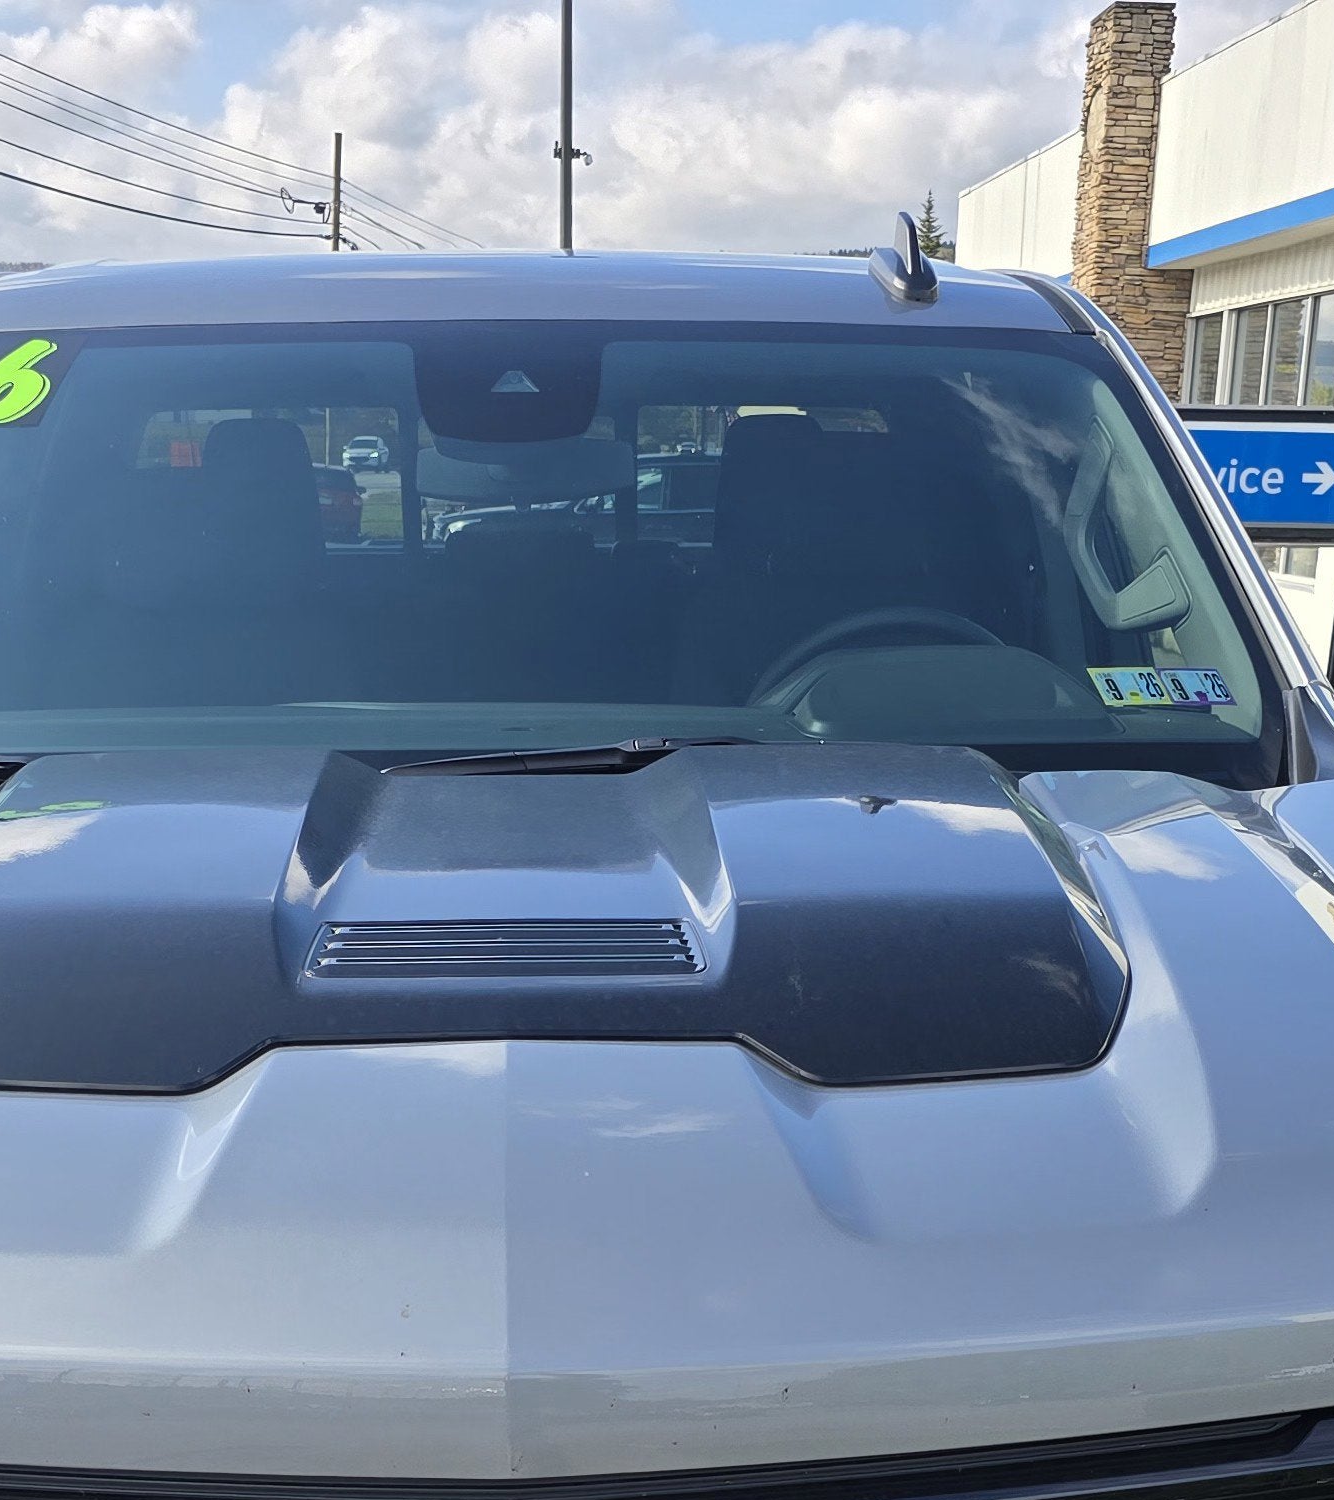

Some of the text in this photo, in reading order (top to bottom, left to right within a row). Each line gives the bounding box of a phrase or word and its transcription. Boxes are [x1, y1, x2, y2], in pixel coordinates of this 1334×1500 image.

[1104, 672, 1165, 701] 9 26
[1170, 673, 1230, 701] 9 26
